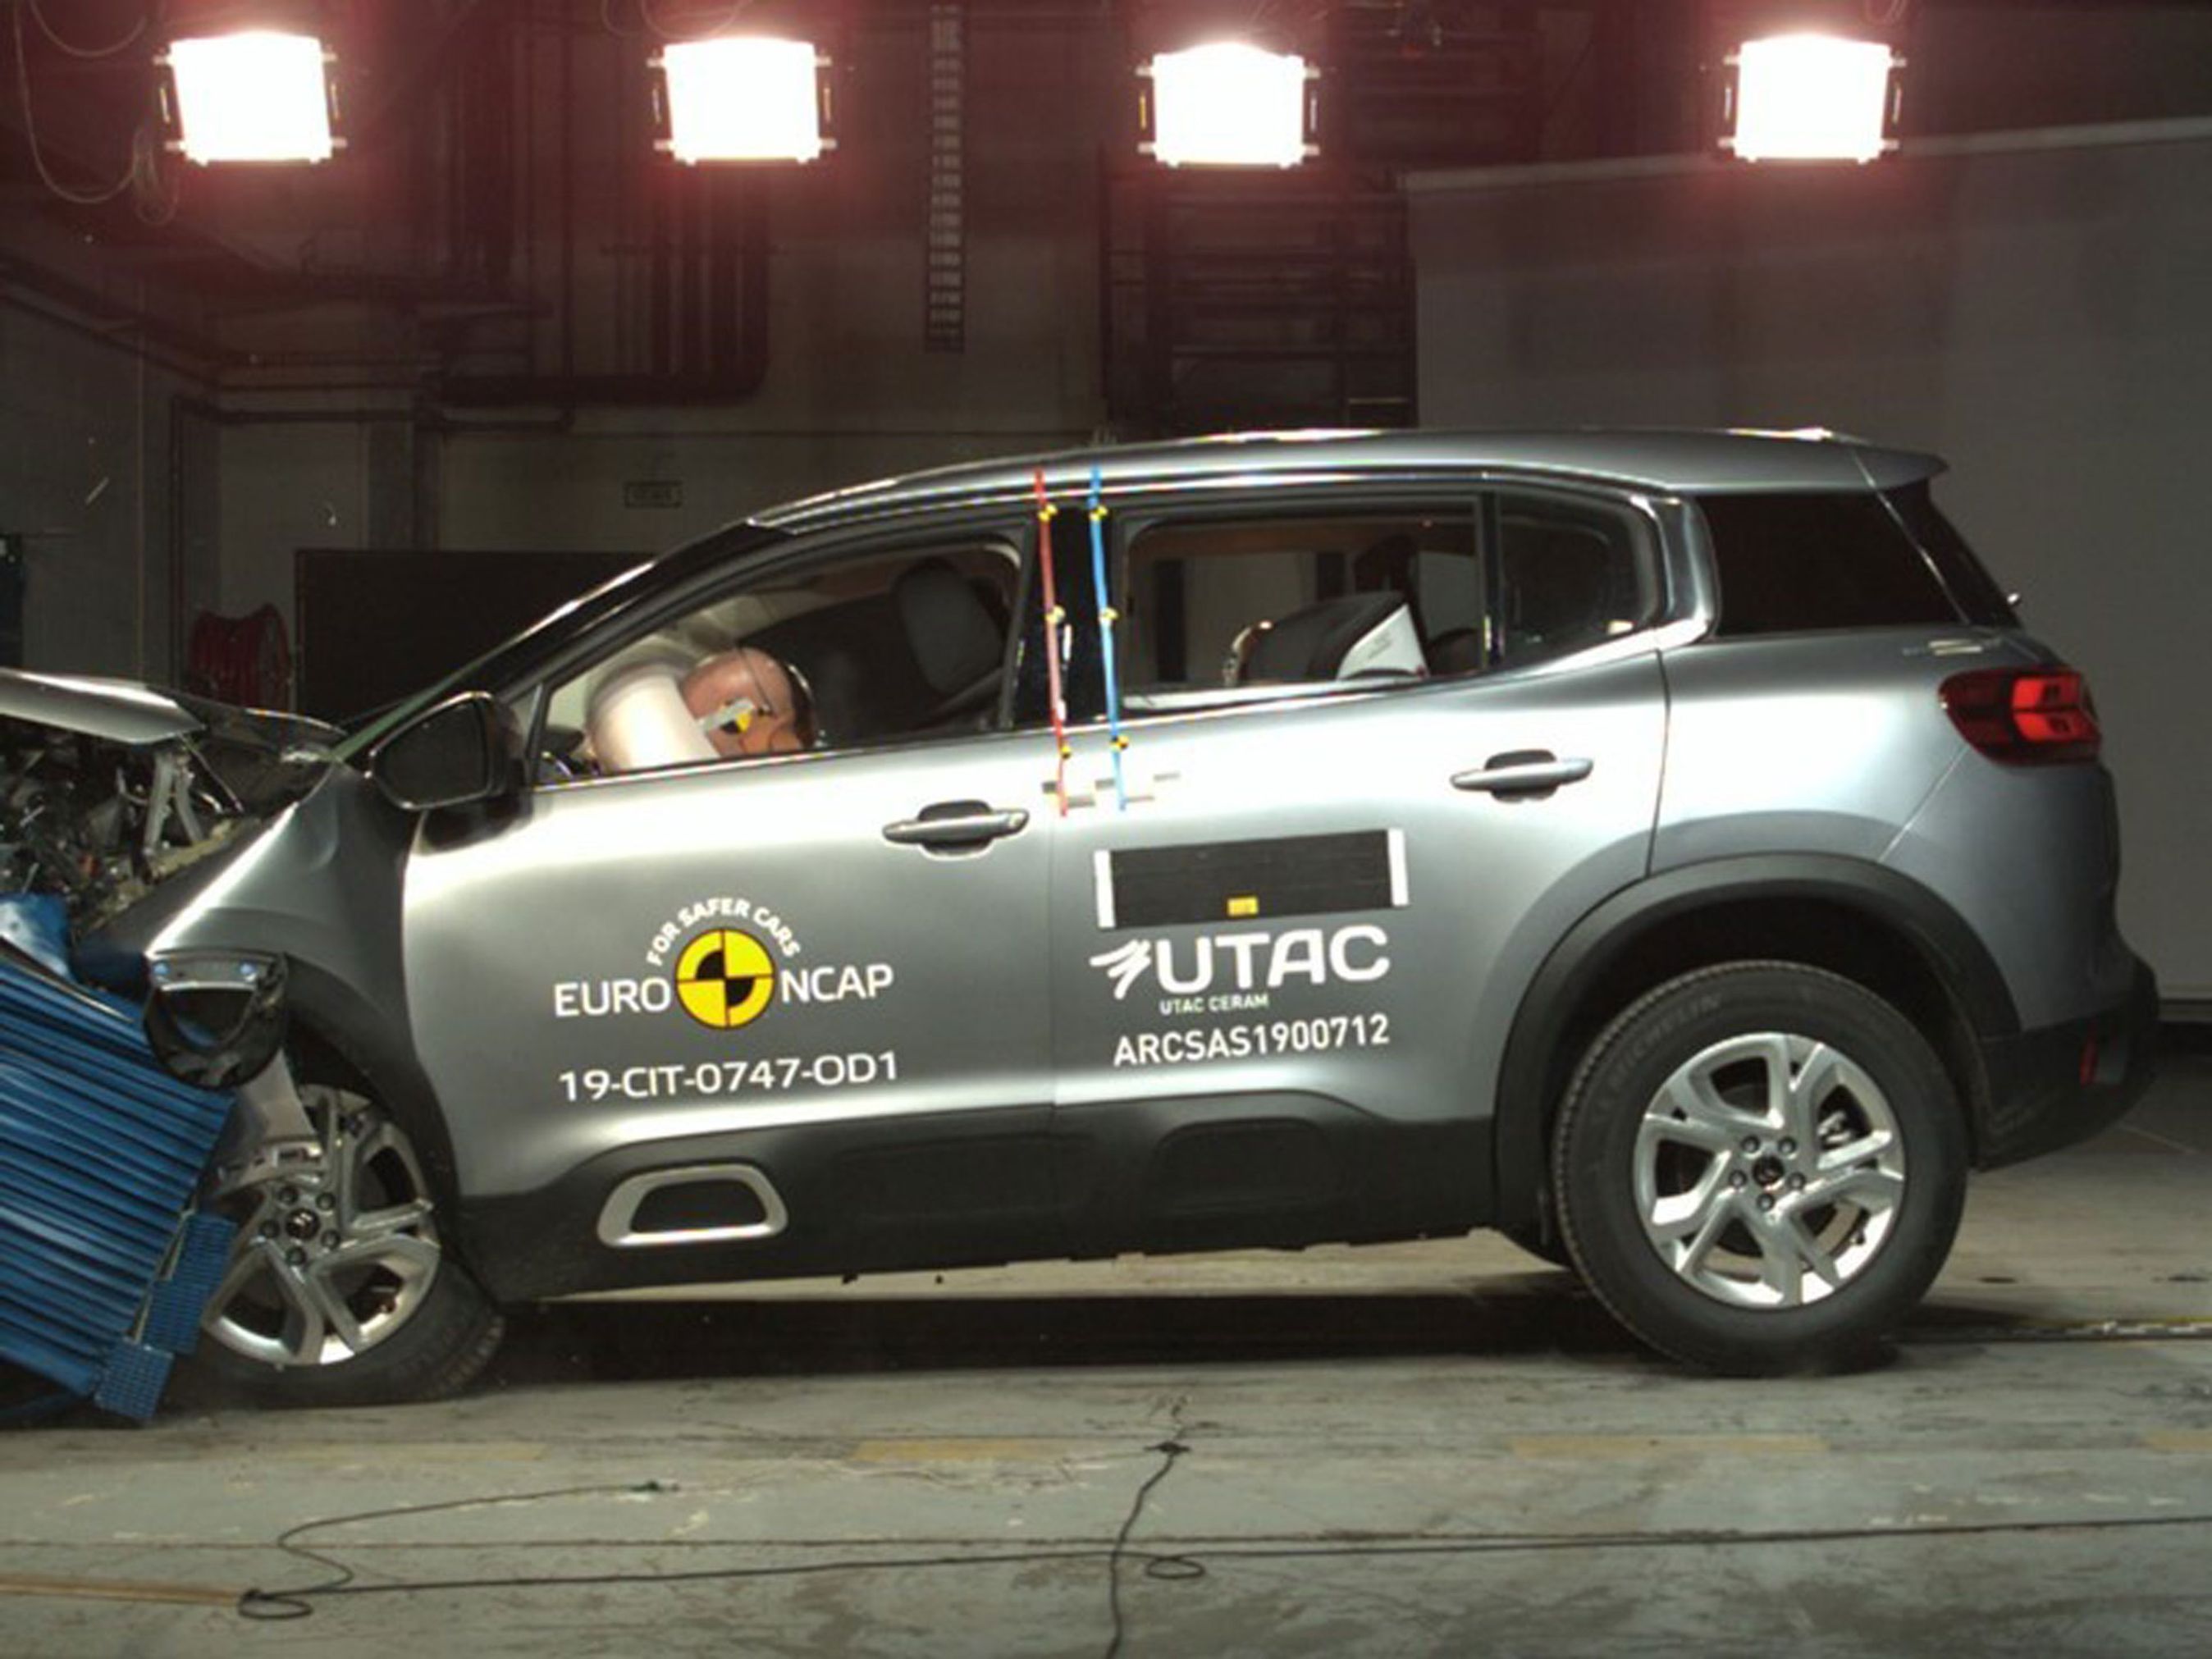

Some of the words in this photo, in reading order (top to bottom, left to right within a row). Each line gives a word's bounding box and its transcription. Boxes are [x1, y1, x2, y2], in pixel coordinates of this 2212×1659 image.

[647, 922, 681, 966] FOR
[678, 898, 750, 926] SAFER
[752, 907, 801, 957] CARS
[1156, 925, 1390, 994] UTAC
[554, 977, 671, 1018] EURO
[781, 963, 893, 1003] NCAP
[1159, 997, 1204, 1015] UTAC
[1209, 994, 1269, 1012] CERAM
[1113, 1013, 1390, 1067] ARCSAS1900712
[559, 1050, 897, 1101] 19-CIT-0747-OD1
